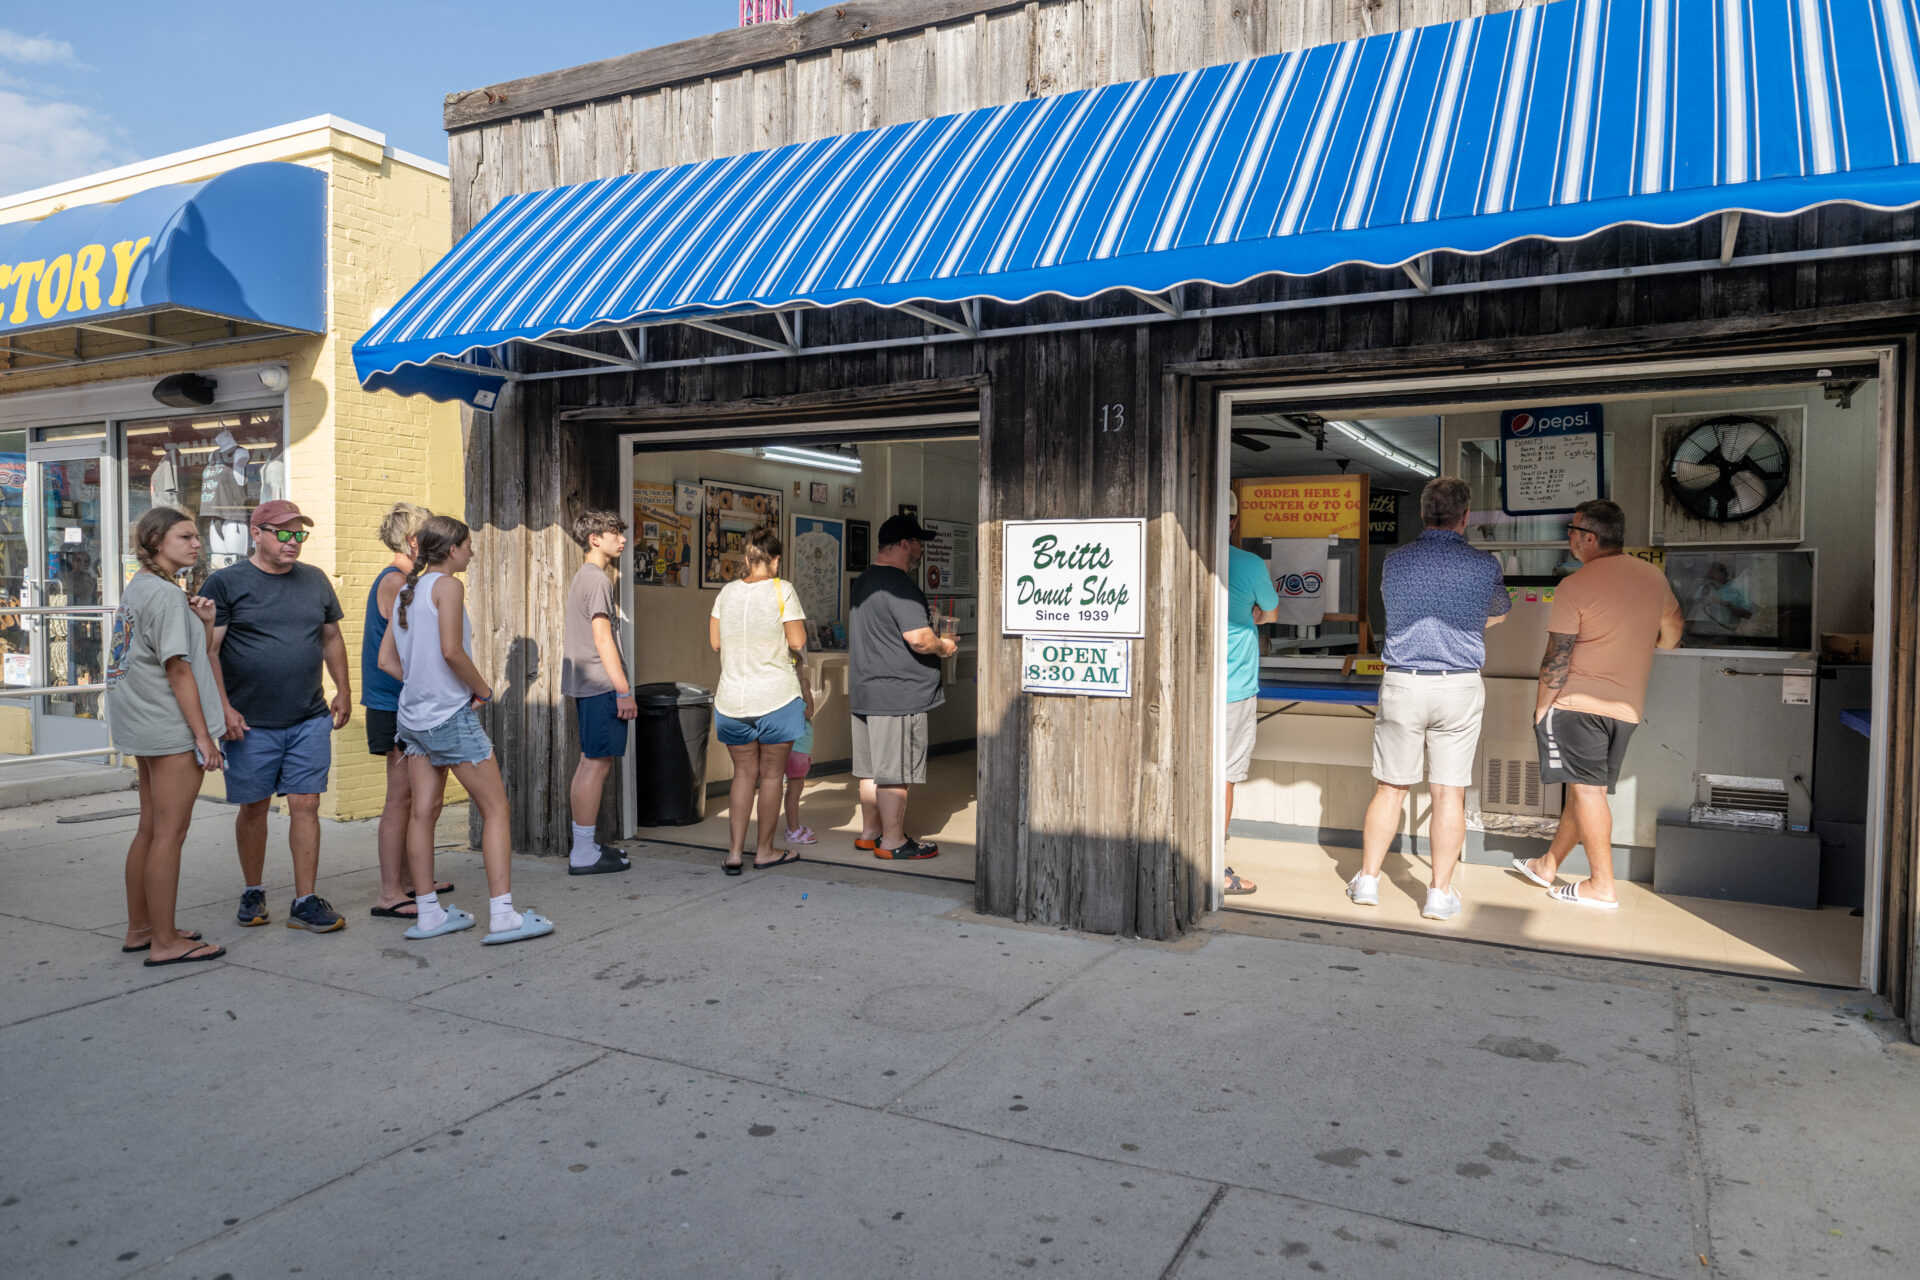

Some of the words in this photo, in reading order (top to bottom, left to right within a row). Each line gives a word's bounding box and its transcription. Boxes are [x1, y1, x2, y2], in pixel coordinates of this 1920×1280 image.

[1102, 403, 1124, 433] 13
[1538, 411, 1589, 433] pepsi
[1564, 449, 1581, 457] Cash
[1253, 488, 1300, 498] ORDER
[1303, 488, 1341, 498] HERE
[1344, 489, 1352, 499] 4
[1241, 500, 1304, 510] COUNTER
[1308, 501, 1319, 510] &
[1322, 500, 1341, 510] TO
[1263, 512, 1299, 522] CASH
[1303, 512, 1340, 522] ONLY
[1032, 534, 1114, 570] Britts
[1628, 551, 1663, 564] SH
[1016, 575, 1074, 606] Donut
[1080, 575, 1130, 615] Shop
[1035, 609, 1070, 621] Since
[1078, 610, 1109, 621] 1939
[1042, 645, 1108, 665] OPEN
[1029, 664, 1075, 682] 8:30
[1081, 666, 1120, 684] AM
